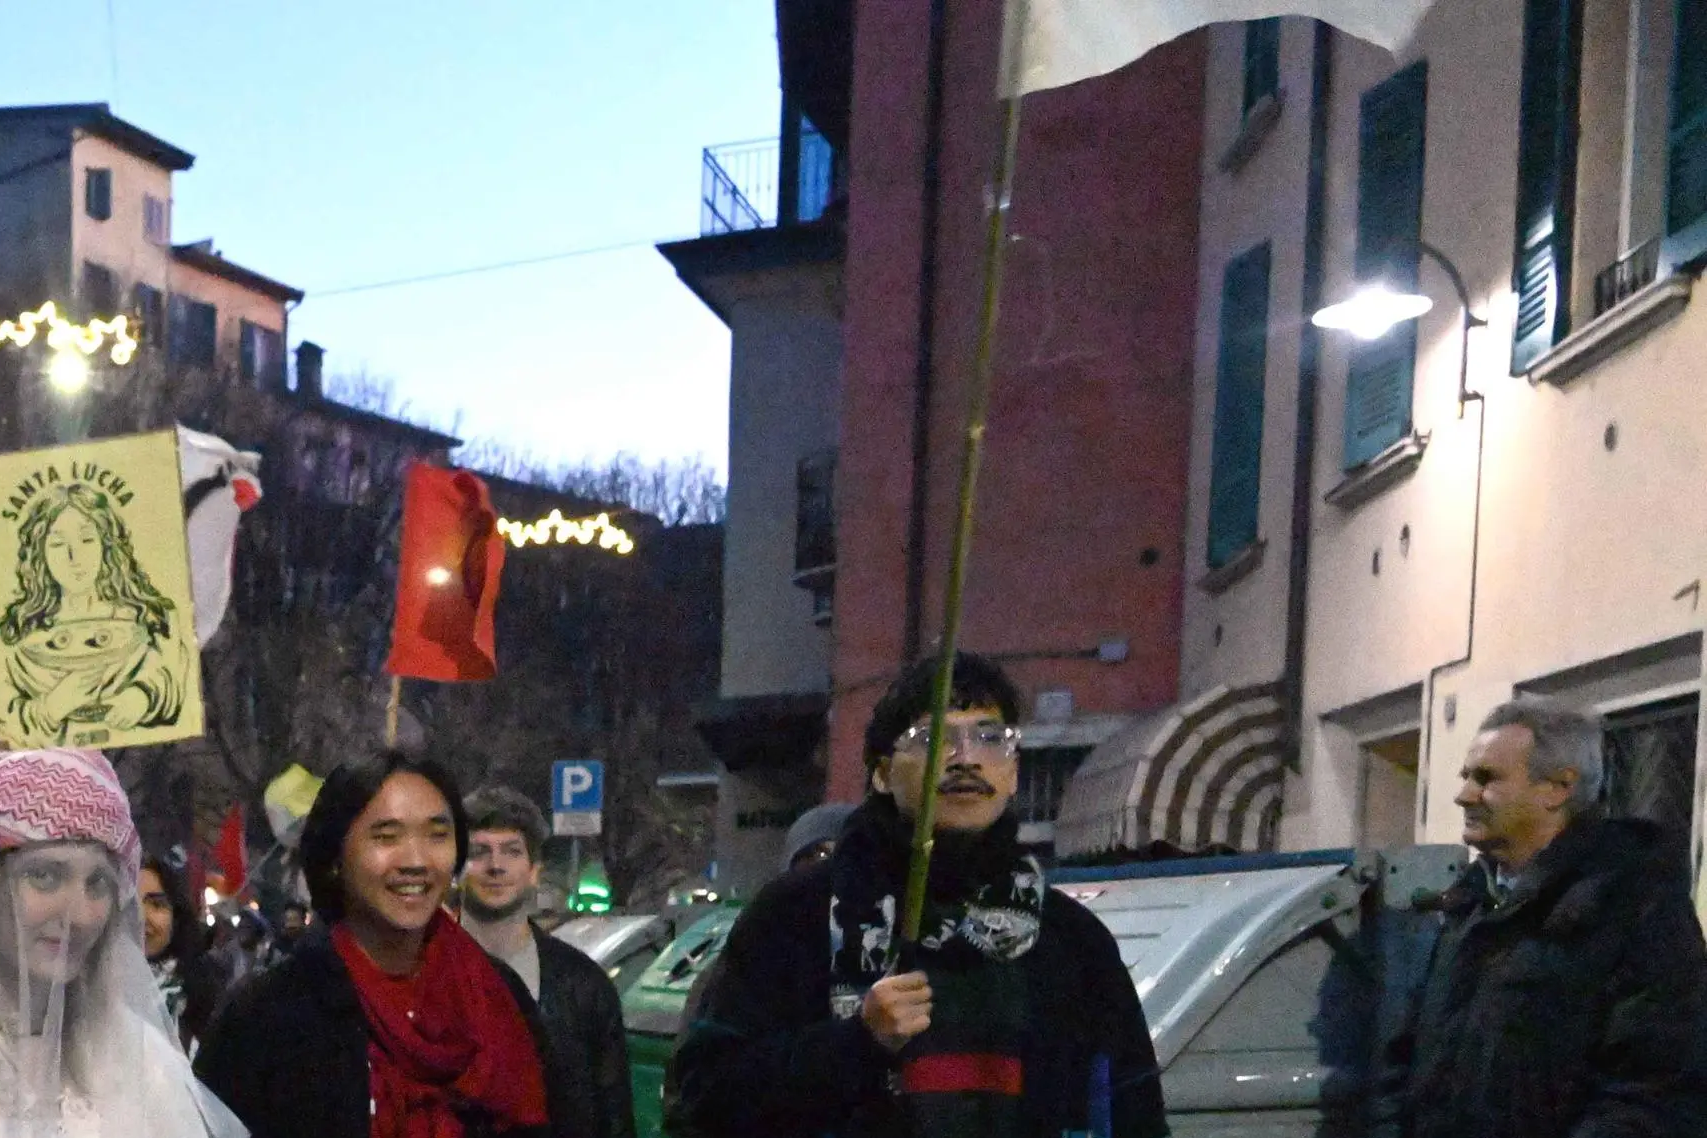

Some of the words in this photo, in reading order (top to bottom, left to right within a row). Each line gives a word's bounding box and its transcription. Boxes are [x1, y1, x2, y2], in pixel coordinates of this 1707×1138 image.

[1, 465, 61, 522] SANTA
[72, 460, 136, 508] LUCHA
[562, 765, 593, 805] P
